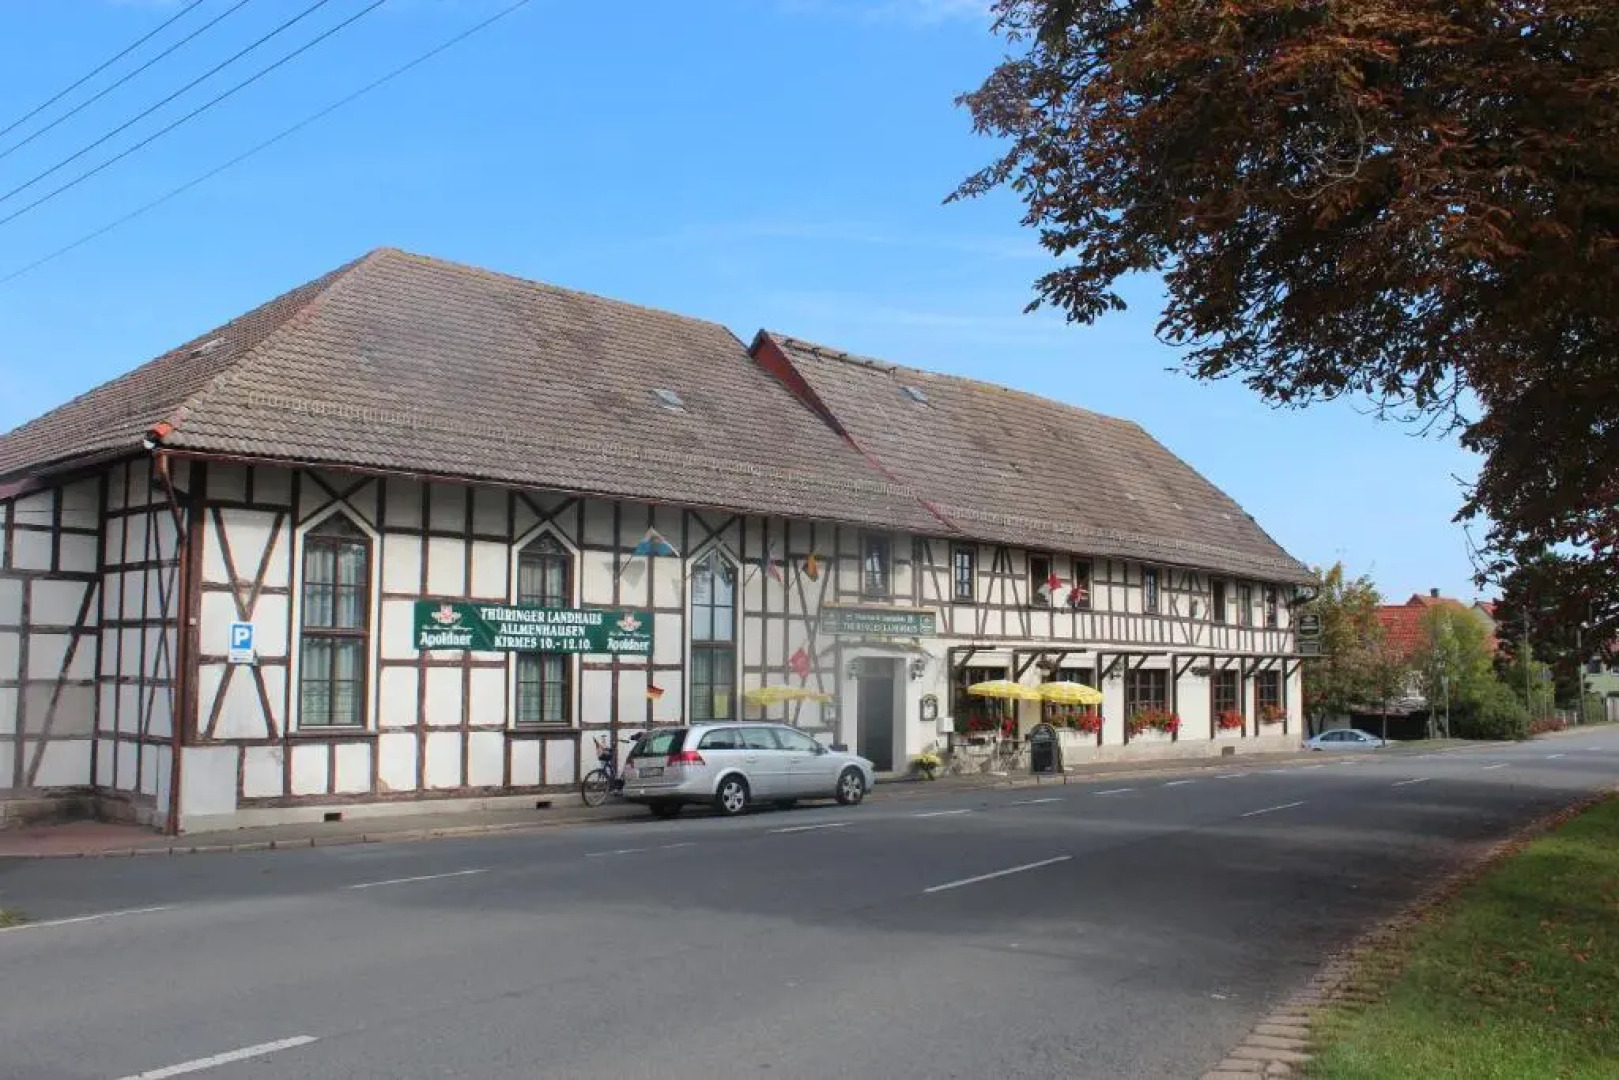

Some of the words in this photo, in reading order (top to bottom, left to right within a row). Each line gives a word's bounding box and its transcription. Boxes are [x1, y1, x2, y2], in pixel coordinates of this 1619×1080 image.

[480, 606, 545, 622] THÜRINGER
[547, 611, 603, 625] LANDHAUS
[233, 627, 250, 646] P
[500, 622, 586, 637] ALLMENHAUSEN
[420, 630, 473, 647] Apoldner
[494, 635, 537, 649] KIRMES
